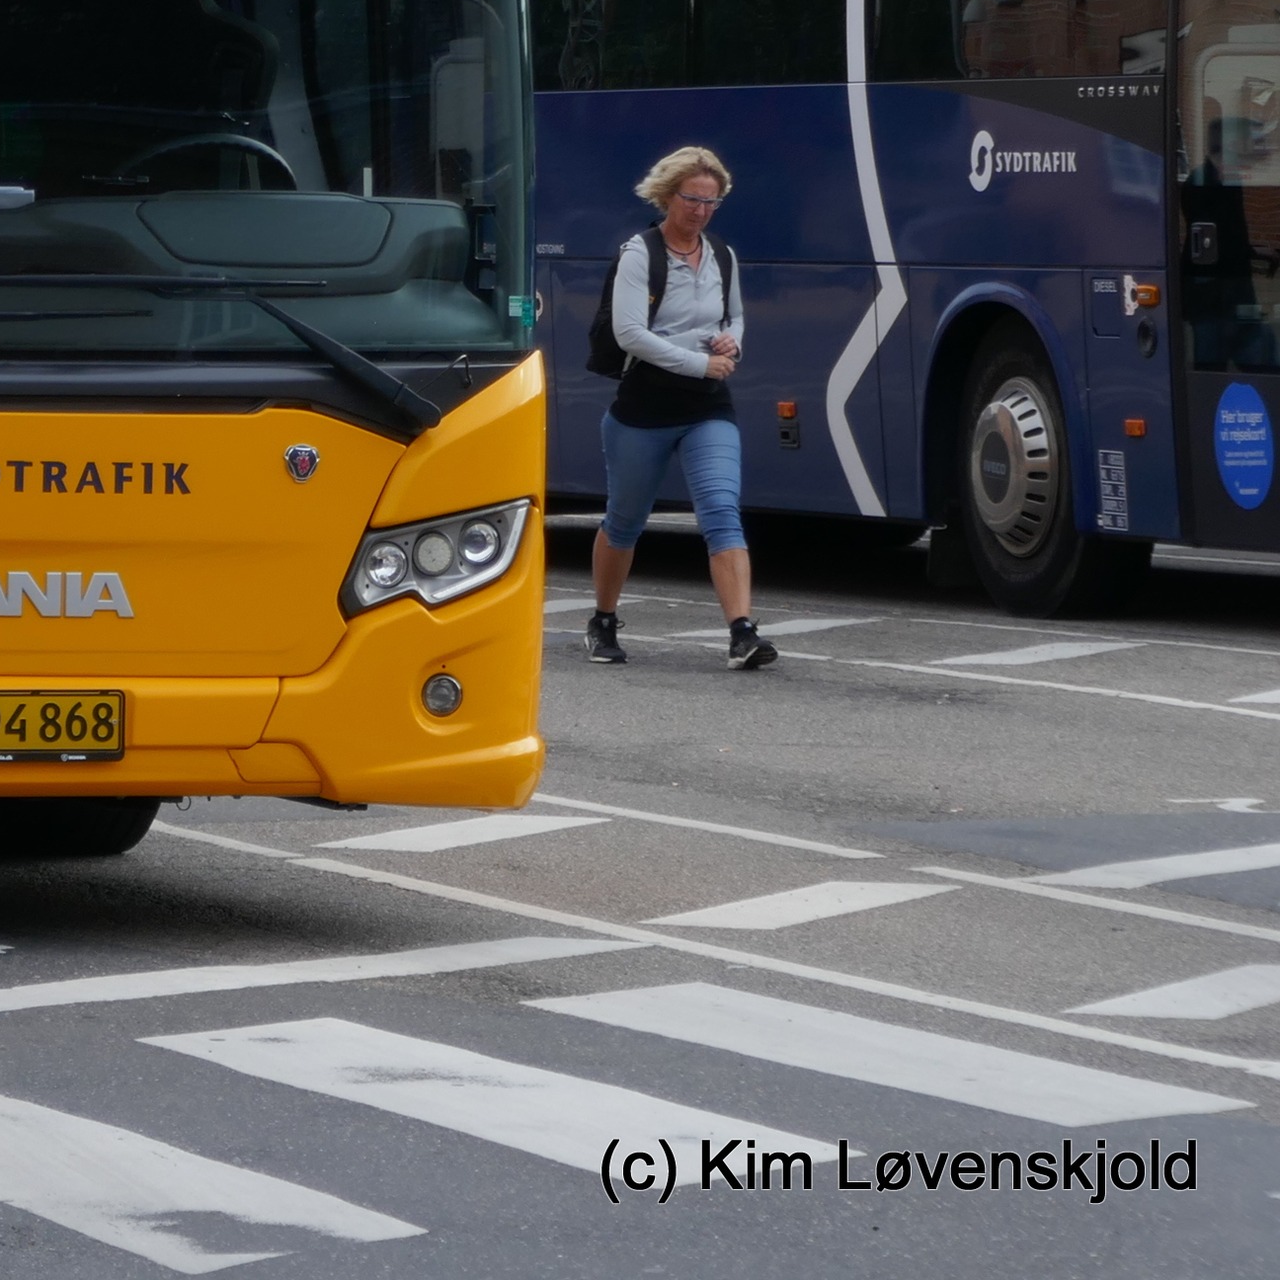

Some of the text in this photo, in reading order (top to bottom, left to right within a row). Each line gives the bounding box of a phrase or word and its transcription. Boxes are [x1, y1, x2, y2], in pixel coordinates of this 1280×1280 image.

[1077, 85, 1161, 98] CROSSWAY
[994, 151, 1078, 173] SYDTRAFIK
[39, 701, 115, 743] 868
